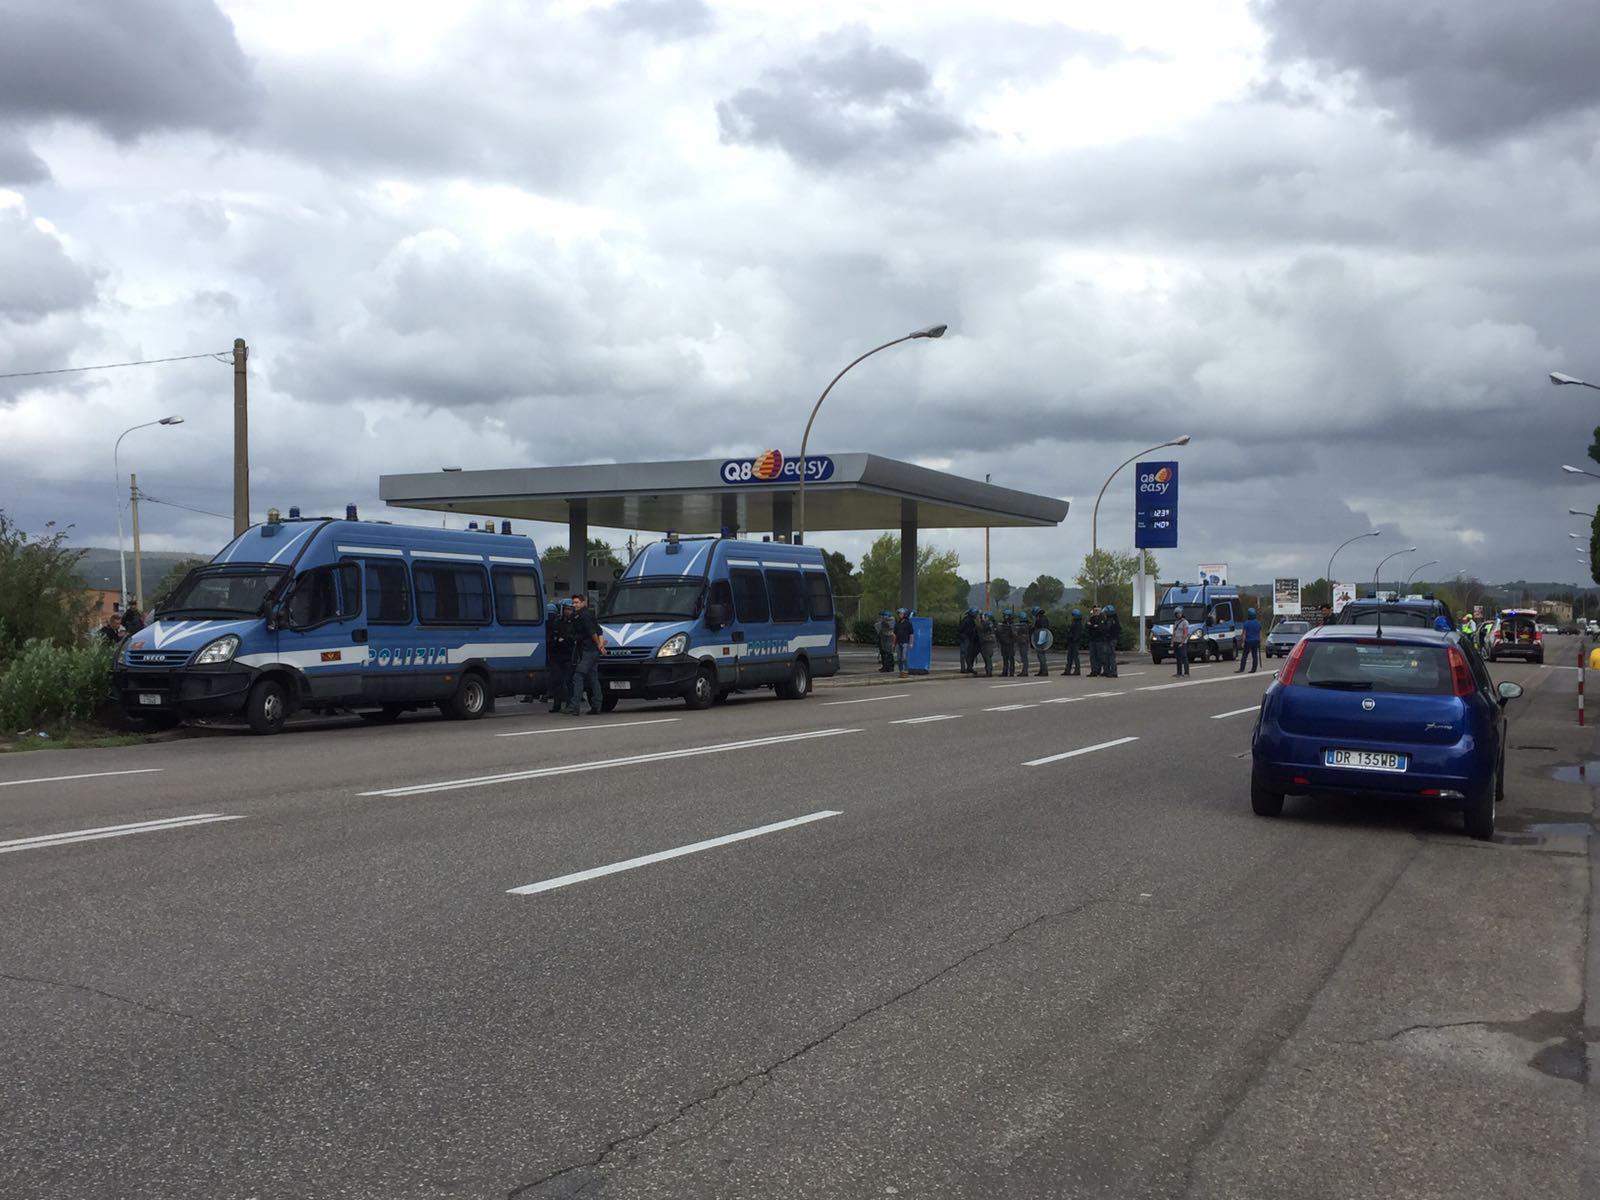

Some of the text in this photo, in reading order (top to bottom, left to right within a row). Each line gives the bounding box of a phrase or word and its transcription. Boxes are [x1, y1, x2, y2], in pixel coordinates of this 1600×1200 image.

[724, 460, 828, 481] Q8 easy
[1140, 474, 1155, 483] Q8
[1140, 483, 1169, 495] easy
[368, 648, 447, 667] POLIZIA
[1335, 750, 1397, 767] DR 135WB
